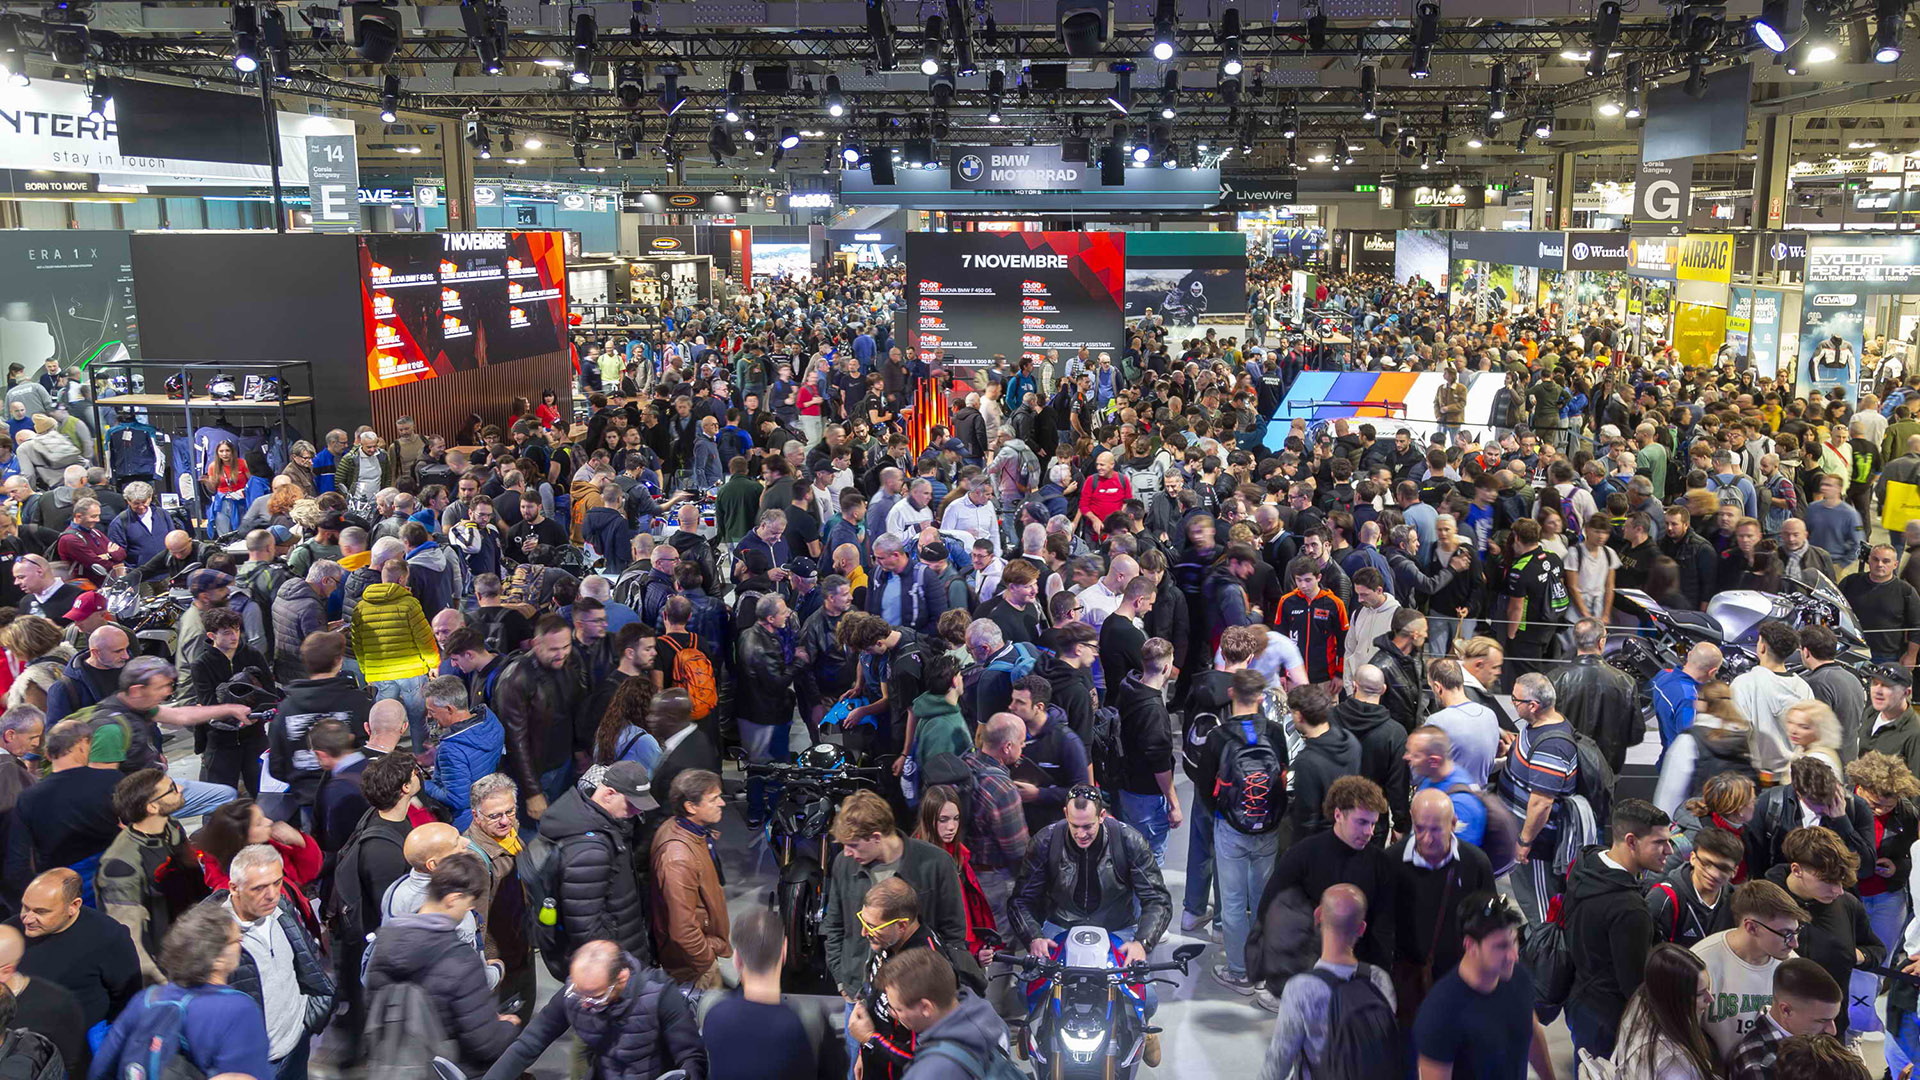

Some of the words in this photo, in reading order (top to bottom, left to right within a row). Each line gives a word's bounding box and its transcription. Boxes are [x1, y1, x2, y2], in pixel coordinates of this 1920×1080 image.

[53, 151, 90, 166] stay
[98, 152, 113, 165] in
[323, 145, 344, 162] 14
[991, 155, 1030, 167] BMW
[991, 169, 1078, 182] MOTORRAD
[25, 182, 50, 191] BORN
[50, 182, 63, 191] TO
[63, 182, 88, 191] MOVE
[1236, 190, 1293, 200] LiveWire
[1414, 188, 1466, 205] LeoVince
[1644, 180, 1680, 220] G
[321, 185, 349, 220] E
[520, 214, 531, 224] 14
[443, 233, 450, 251] 7
[450, 233, 506, 251] NOVEMBRE
[1364, 235, 1395, 249] LeoVince
[28, 249, 62, 260] ERA
[73, 248, 79, 259] 1
[91, 248, 97, 258] X
[1681, 241, 1728, 269] AIRBAG
[1811, 254, 1883, 264] EVOLUTA
[962, 254, 972, 268] 7
[974, 254, 1068, 269] NOVEMBRE
[1810, 265, 1840, 275] PER
[1708, 992, 1738, 1023] LOS
